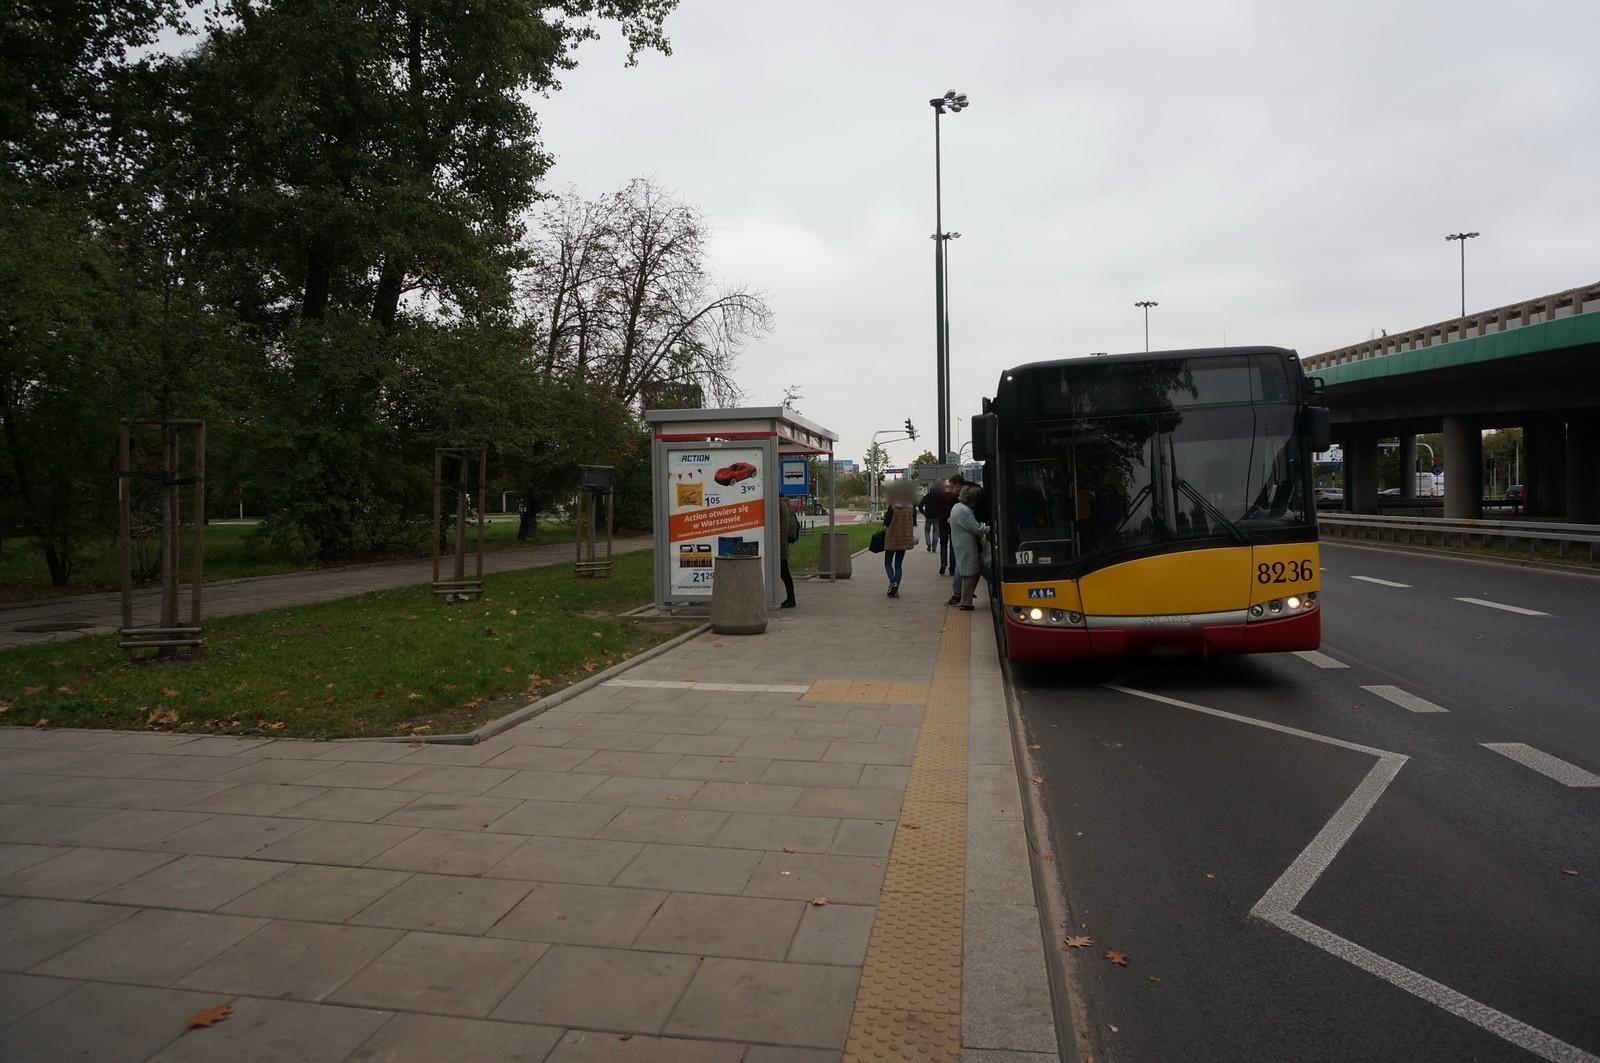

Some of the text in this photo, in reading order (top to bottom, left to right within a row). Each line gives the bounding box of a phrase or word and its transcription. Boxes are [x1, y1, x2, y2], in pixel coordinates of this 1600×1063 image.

[681, 454, 710, 463] ACTION
[684, 504, 749, 522] Action otwiera się
[701, 514, 741, 527] Warszawie
[1257, 559, 1313, 584] 8236
